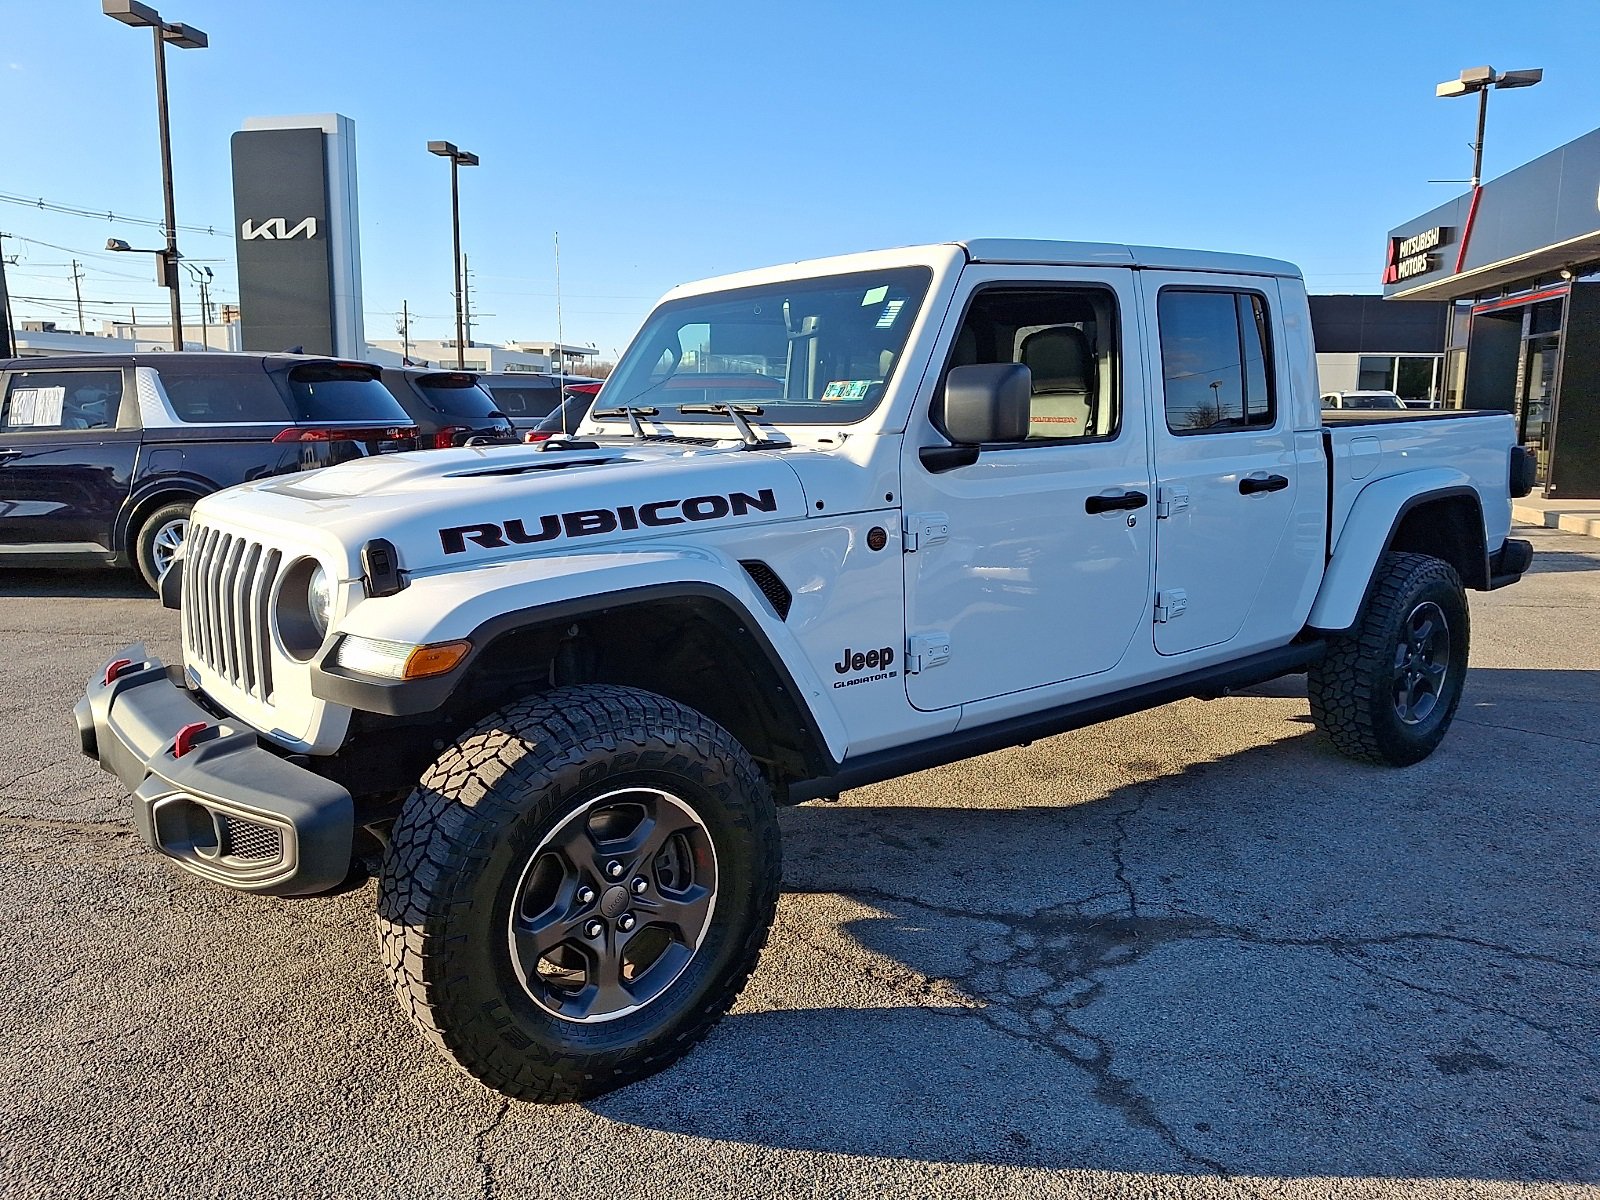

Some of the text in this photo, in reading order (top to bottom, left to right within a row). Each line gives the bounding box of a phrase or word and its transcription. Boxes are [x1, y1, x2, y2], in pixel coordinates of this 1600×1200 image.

[242, 217, 317, 240] KIA
[1399, 226, 1440, 259] MITSUBISHI
[1398, 252, 1428, 280] MOTORS
[438, 488, 778, 555] RUBICON
[834, 646, 895, 675] Jeep
[833, 672, 888, 689] GLADIATOR
